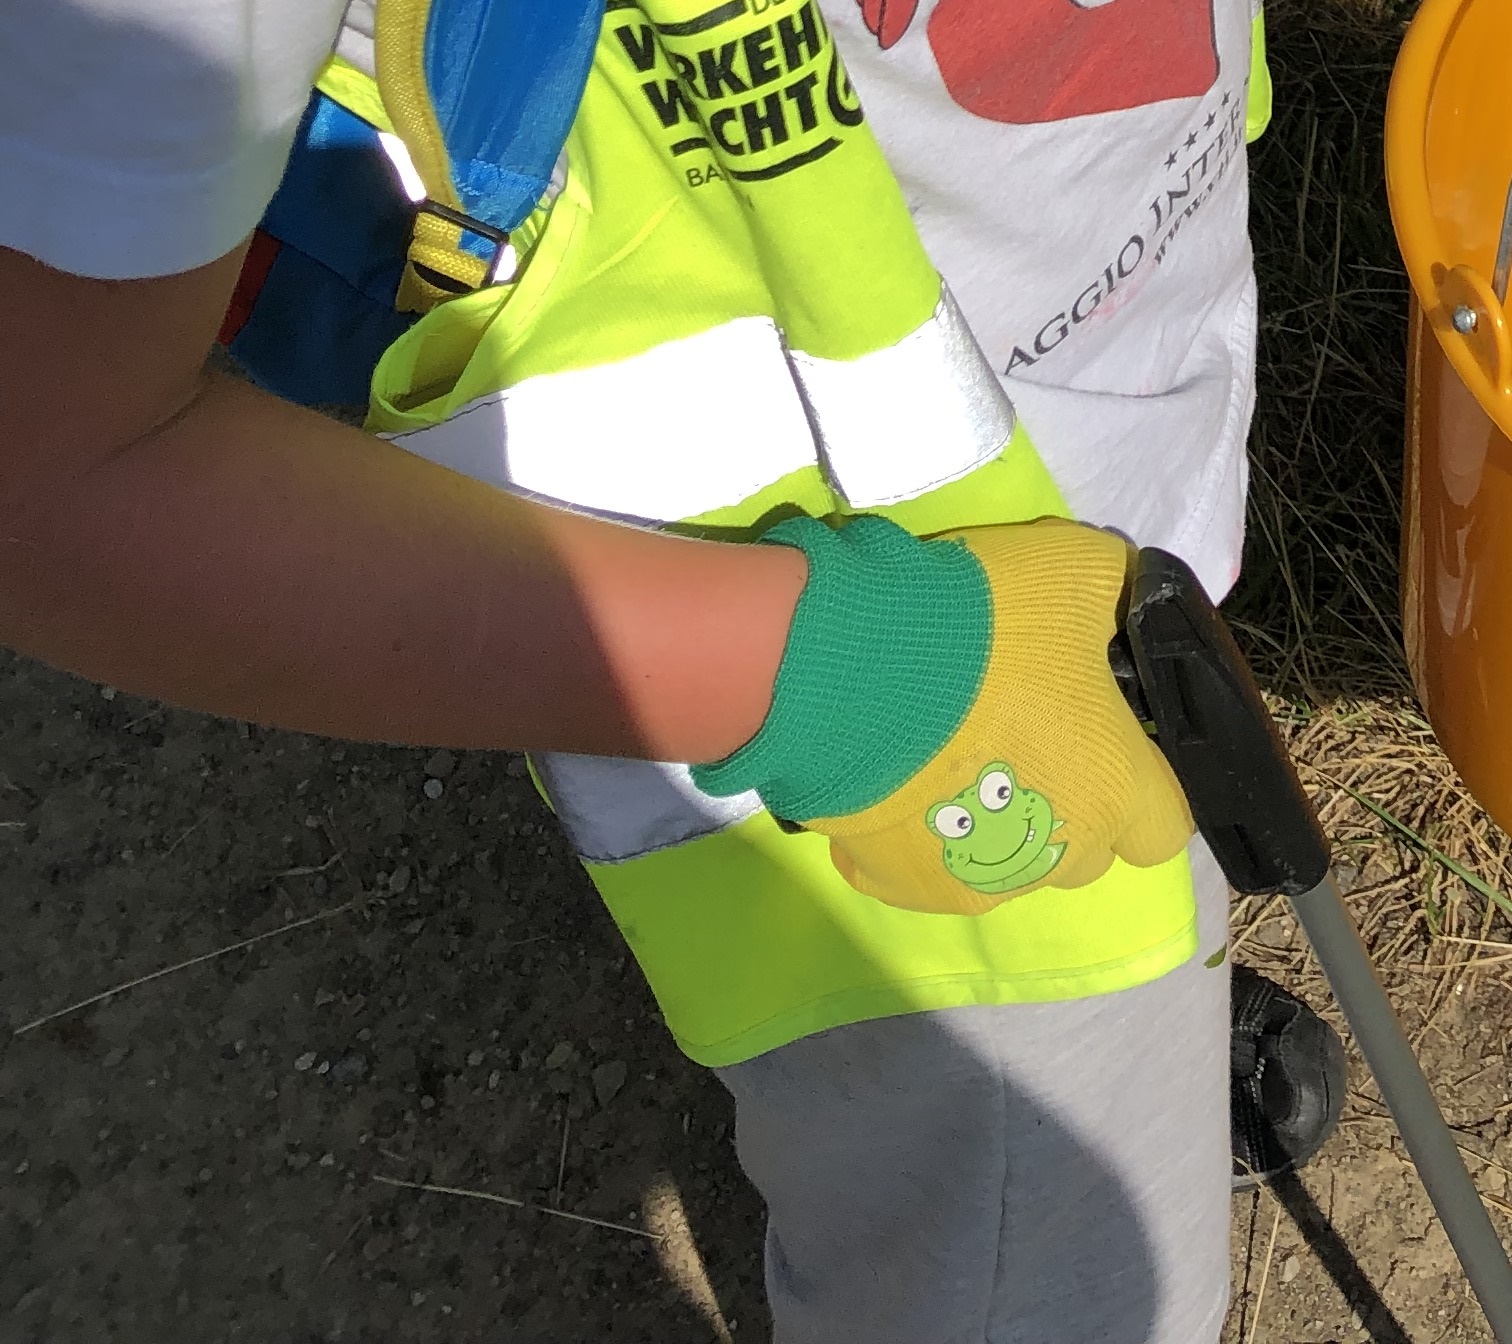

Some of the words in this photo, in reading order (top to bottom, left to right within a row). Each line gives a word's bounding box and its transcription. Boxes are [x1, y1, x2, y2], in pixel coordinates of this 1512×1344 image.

[614, 8, 830, 101] VRKEH
[641, 76, 824, 157] WCHT
[686, 164, 727, 190] BA
[1003, 234, 1145, 376] AGGIO
[1148, 98, 1241, 237] INTER
